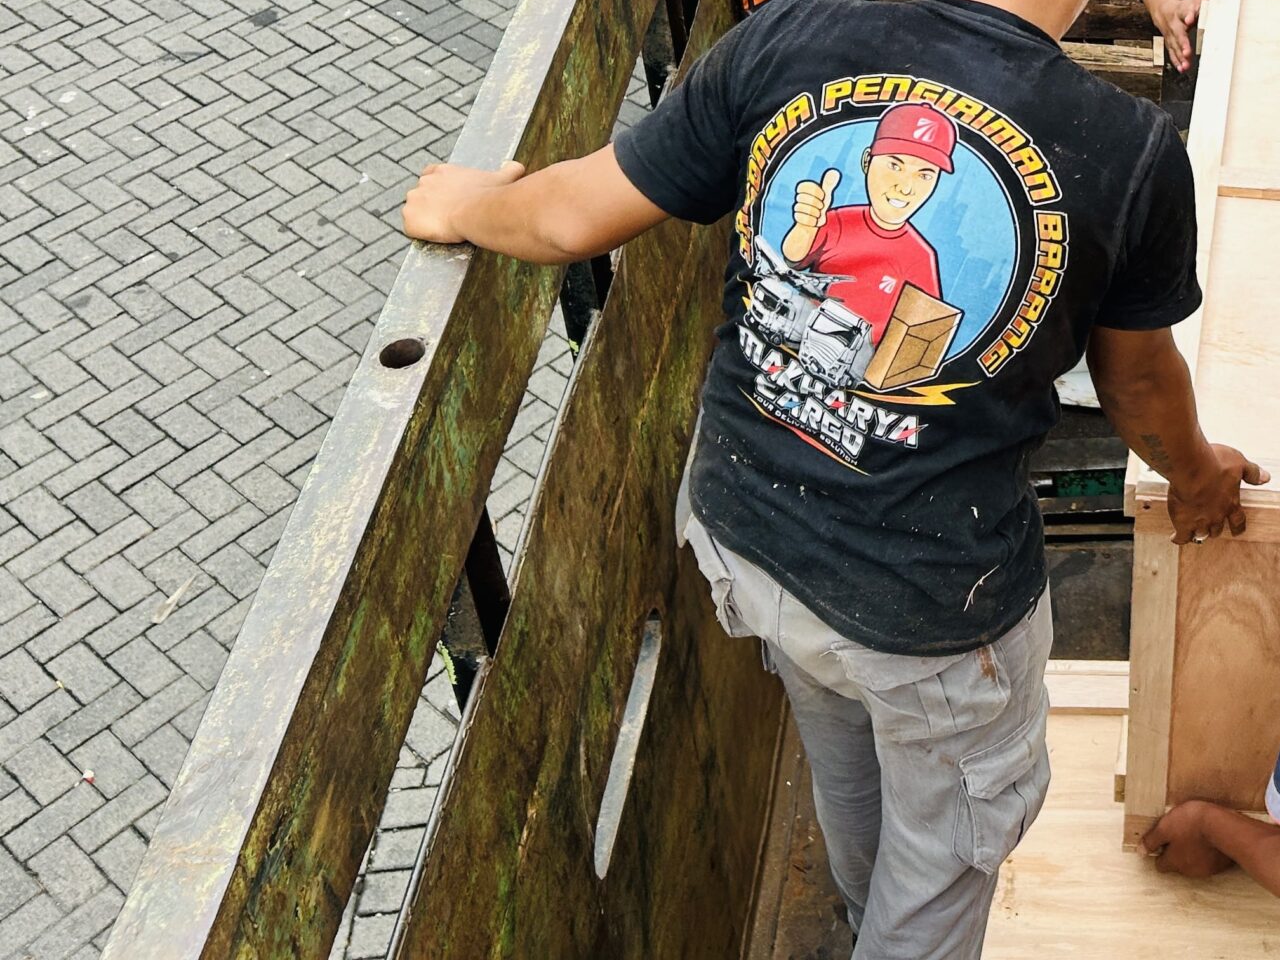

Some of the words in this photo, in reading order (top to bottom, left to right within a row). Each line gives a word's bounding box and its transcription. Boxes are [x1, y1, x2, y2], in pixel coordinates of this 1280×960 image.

[824, 76, 1059, 202] PENGIRIMAN
[981, 211, 1068, 374] BARANG
[739, 325, 922, 448] MAKHARYA
[753, 393, 773, 413] YOUR
[819, 434, 859, 466] SOLUTION
[754, 374, 866, 459] CARGO
